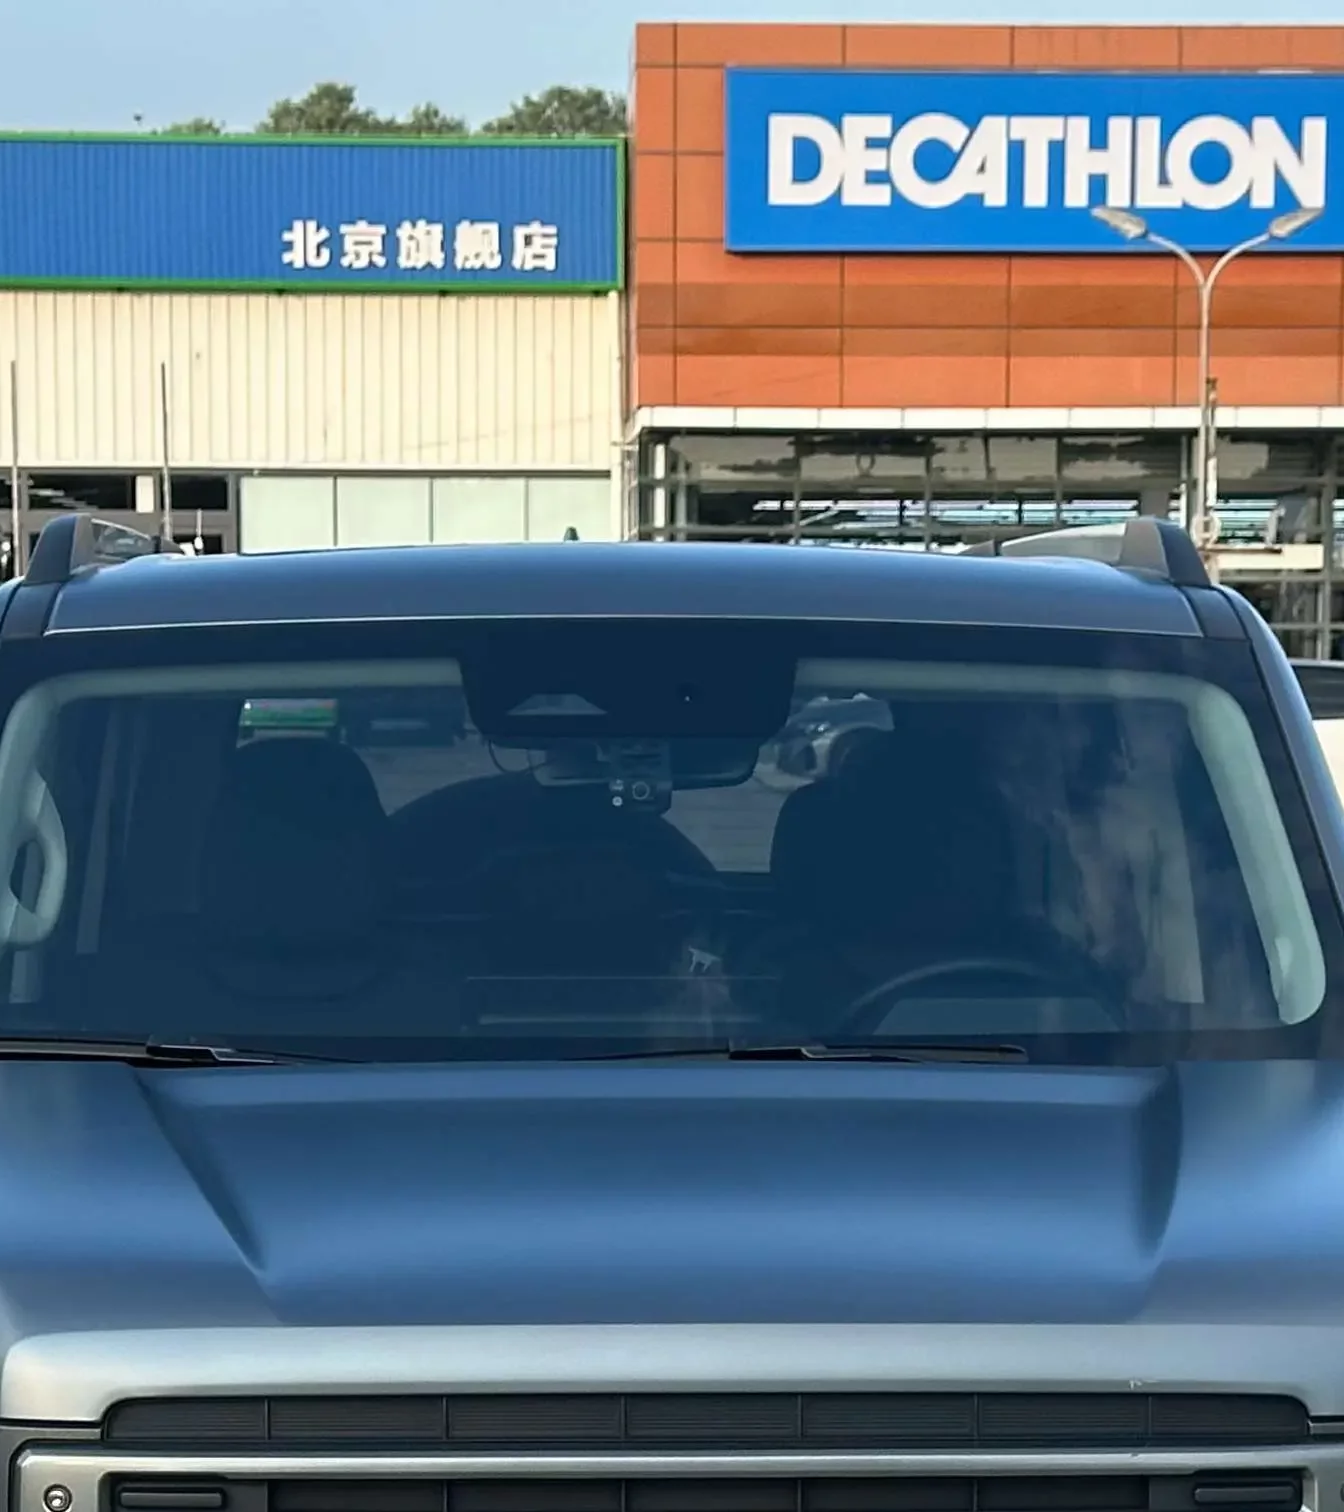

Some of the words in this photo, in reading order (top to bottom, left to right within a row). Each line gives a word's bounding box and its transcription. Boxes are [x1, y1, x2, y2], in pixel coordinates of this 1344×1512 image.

[766, 111, 1328, 210] DECATHLON
[281, 219, 560, 271] 北京旗舰店
